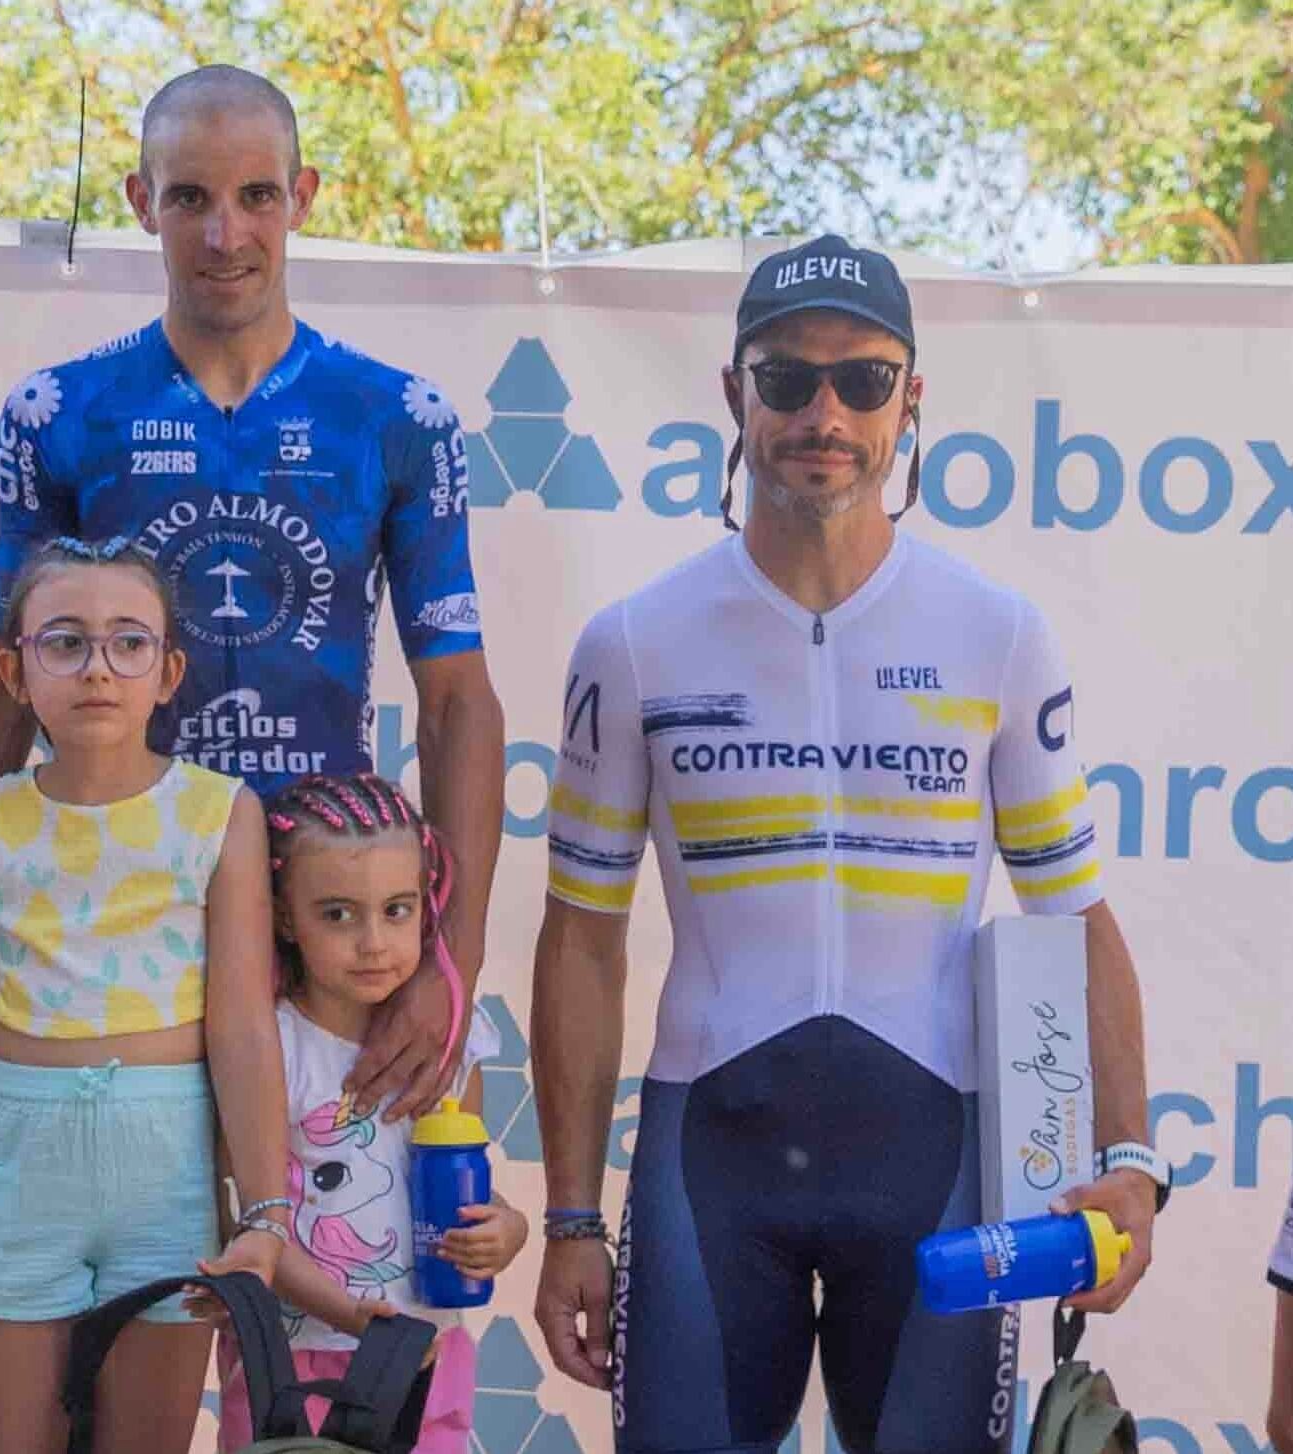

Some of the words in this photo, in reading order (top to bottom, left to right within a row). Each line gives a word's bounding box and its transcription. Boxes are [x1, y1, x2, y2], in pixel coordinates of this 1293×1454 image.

[774, 256, 868, 289] ULEVEL
[132, 419, 196, 441] GOBIK
[130, 451, 197, 475] 226ERS
[207, 495, 336, 651] ALMODOVAR
[876, 667, 943, 689] ULEVEL
[179, 708, 297, 739] ciclos
[904, 774, 967, 794] TEAM
